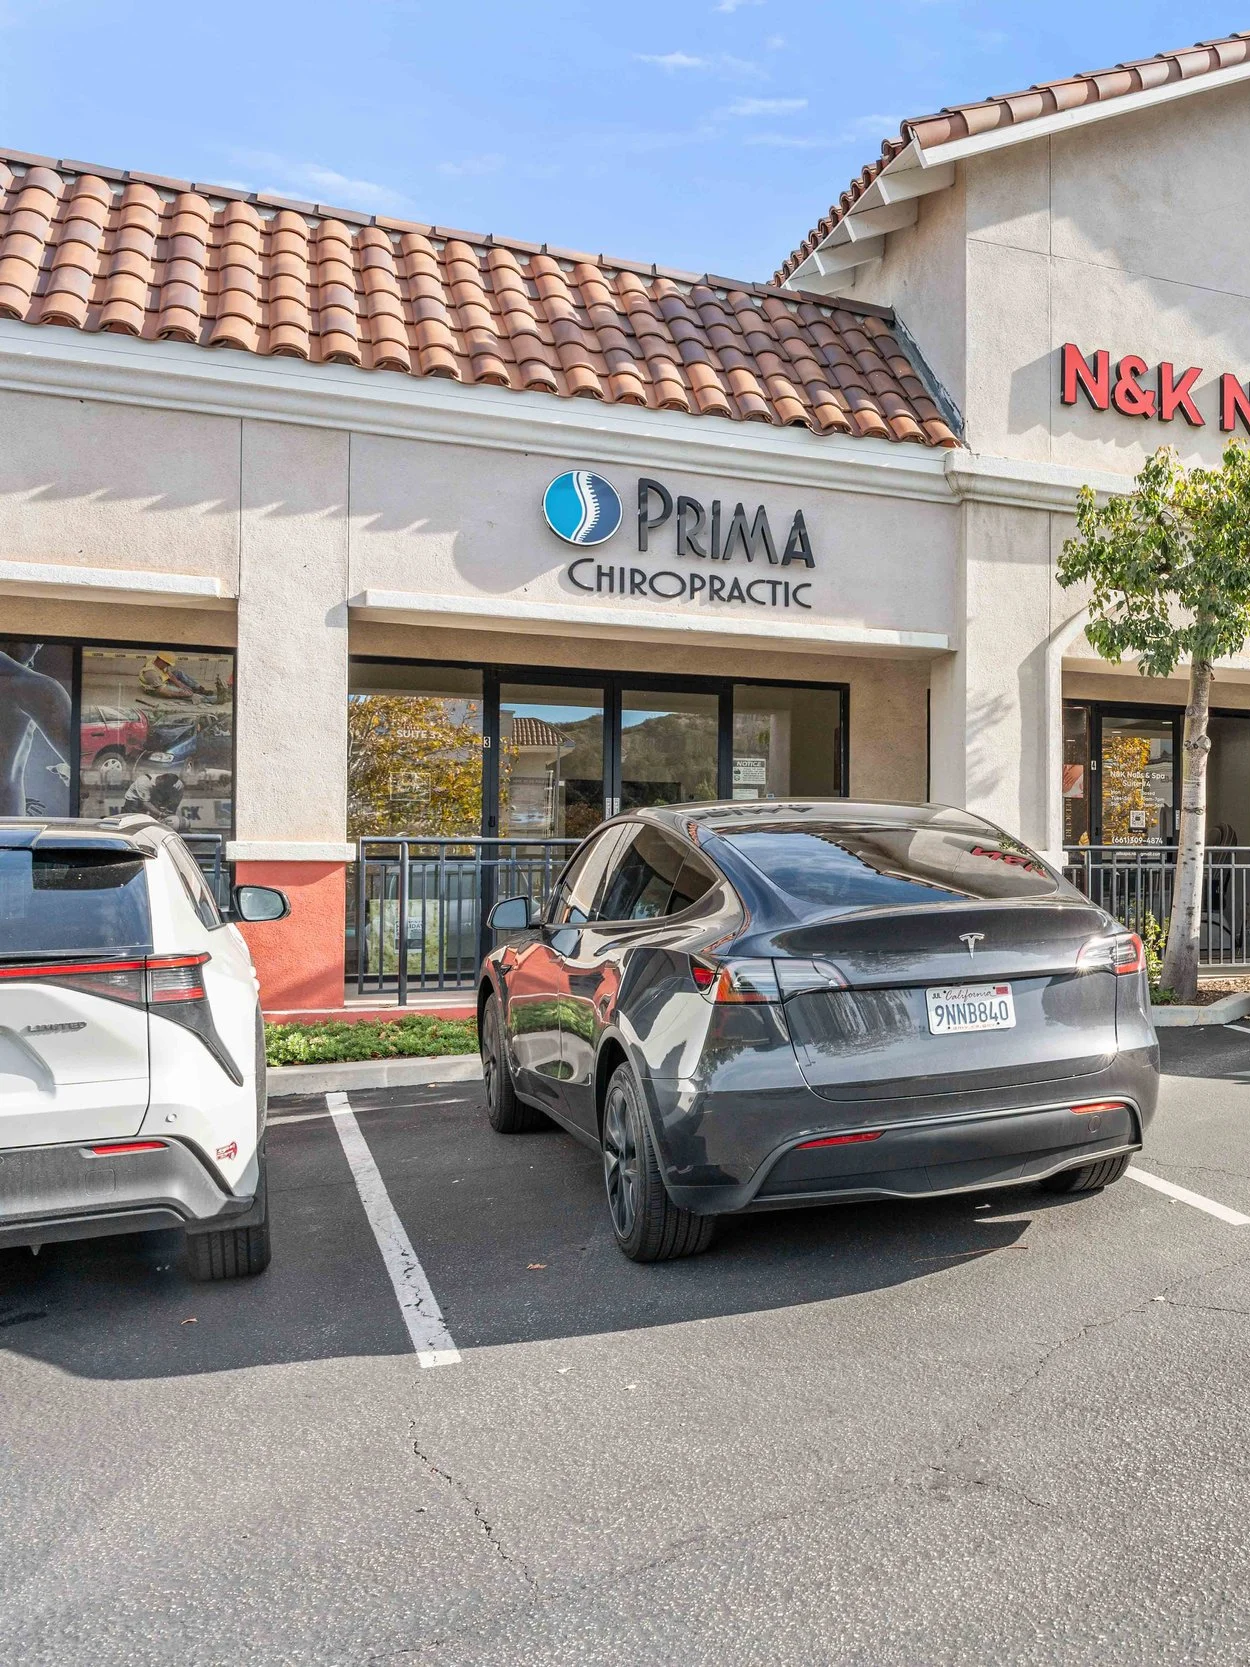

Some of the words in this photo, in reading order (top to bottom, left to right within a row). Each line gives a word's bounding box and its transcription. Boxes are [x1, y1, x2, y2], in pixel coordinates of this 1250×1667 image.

[1060, 342, 1206, 427] N&K
[637, 477, 816, 569] PRIMA
[567, 557, 812, 609] CHIROPRACTIC
[396, 729, 427, 739] SUITE
[484, 737, 490, 747] 3
[1151, 772, 1166, 780] Spa
[1111, 836, 1163, 845] (661)309-4874
[945, 989, 993, 1002] California
[934, 1000, 1009, 1027] 9NNB840
[27, 1021, 87, 1033] LIMITED
